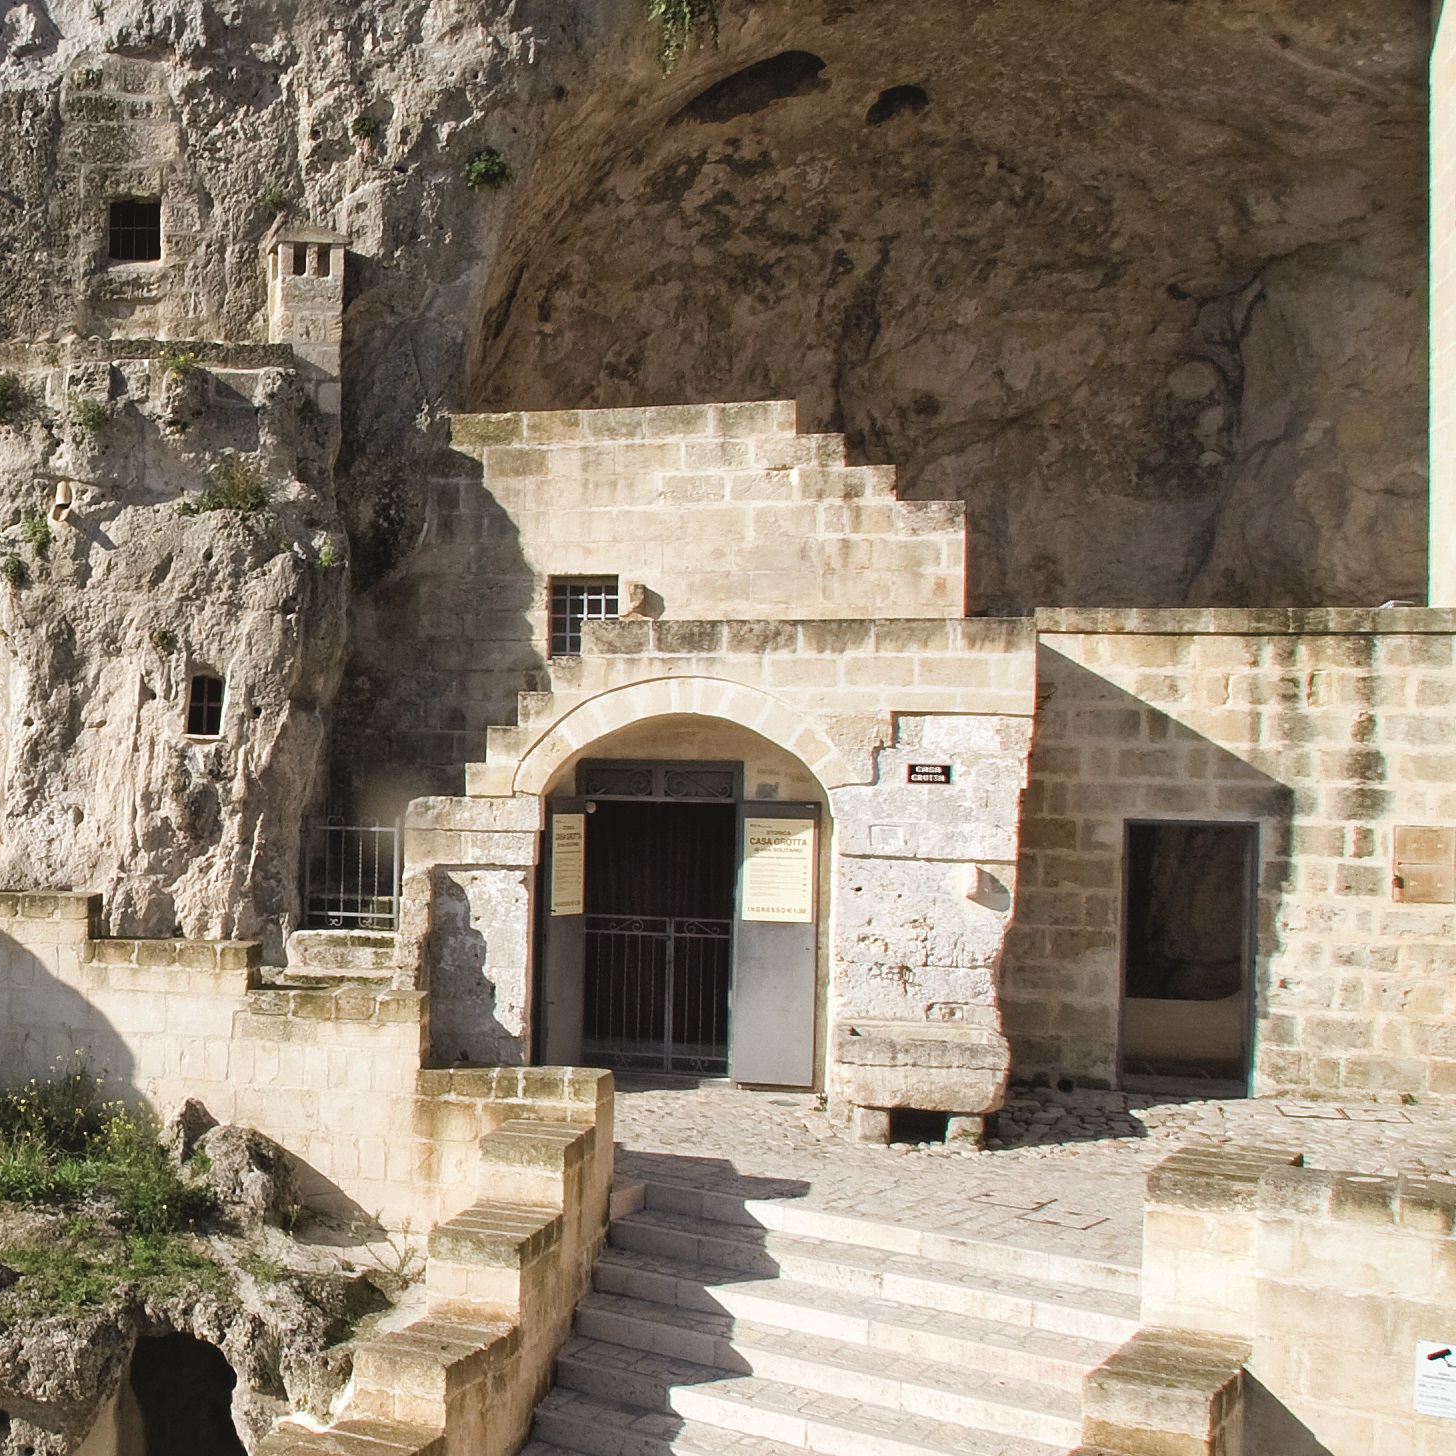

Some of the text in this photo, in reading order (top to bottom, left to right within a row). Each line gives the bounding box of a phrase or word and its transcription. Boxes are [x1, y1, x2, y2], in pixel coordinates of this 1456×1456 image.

[911, 774, 946, 782] GROTTA
[750, 837, 807, 846] CASA GROTTA
